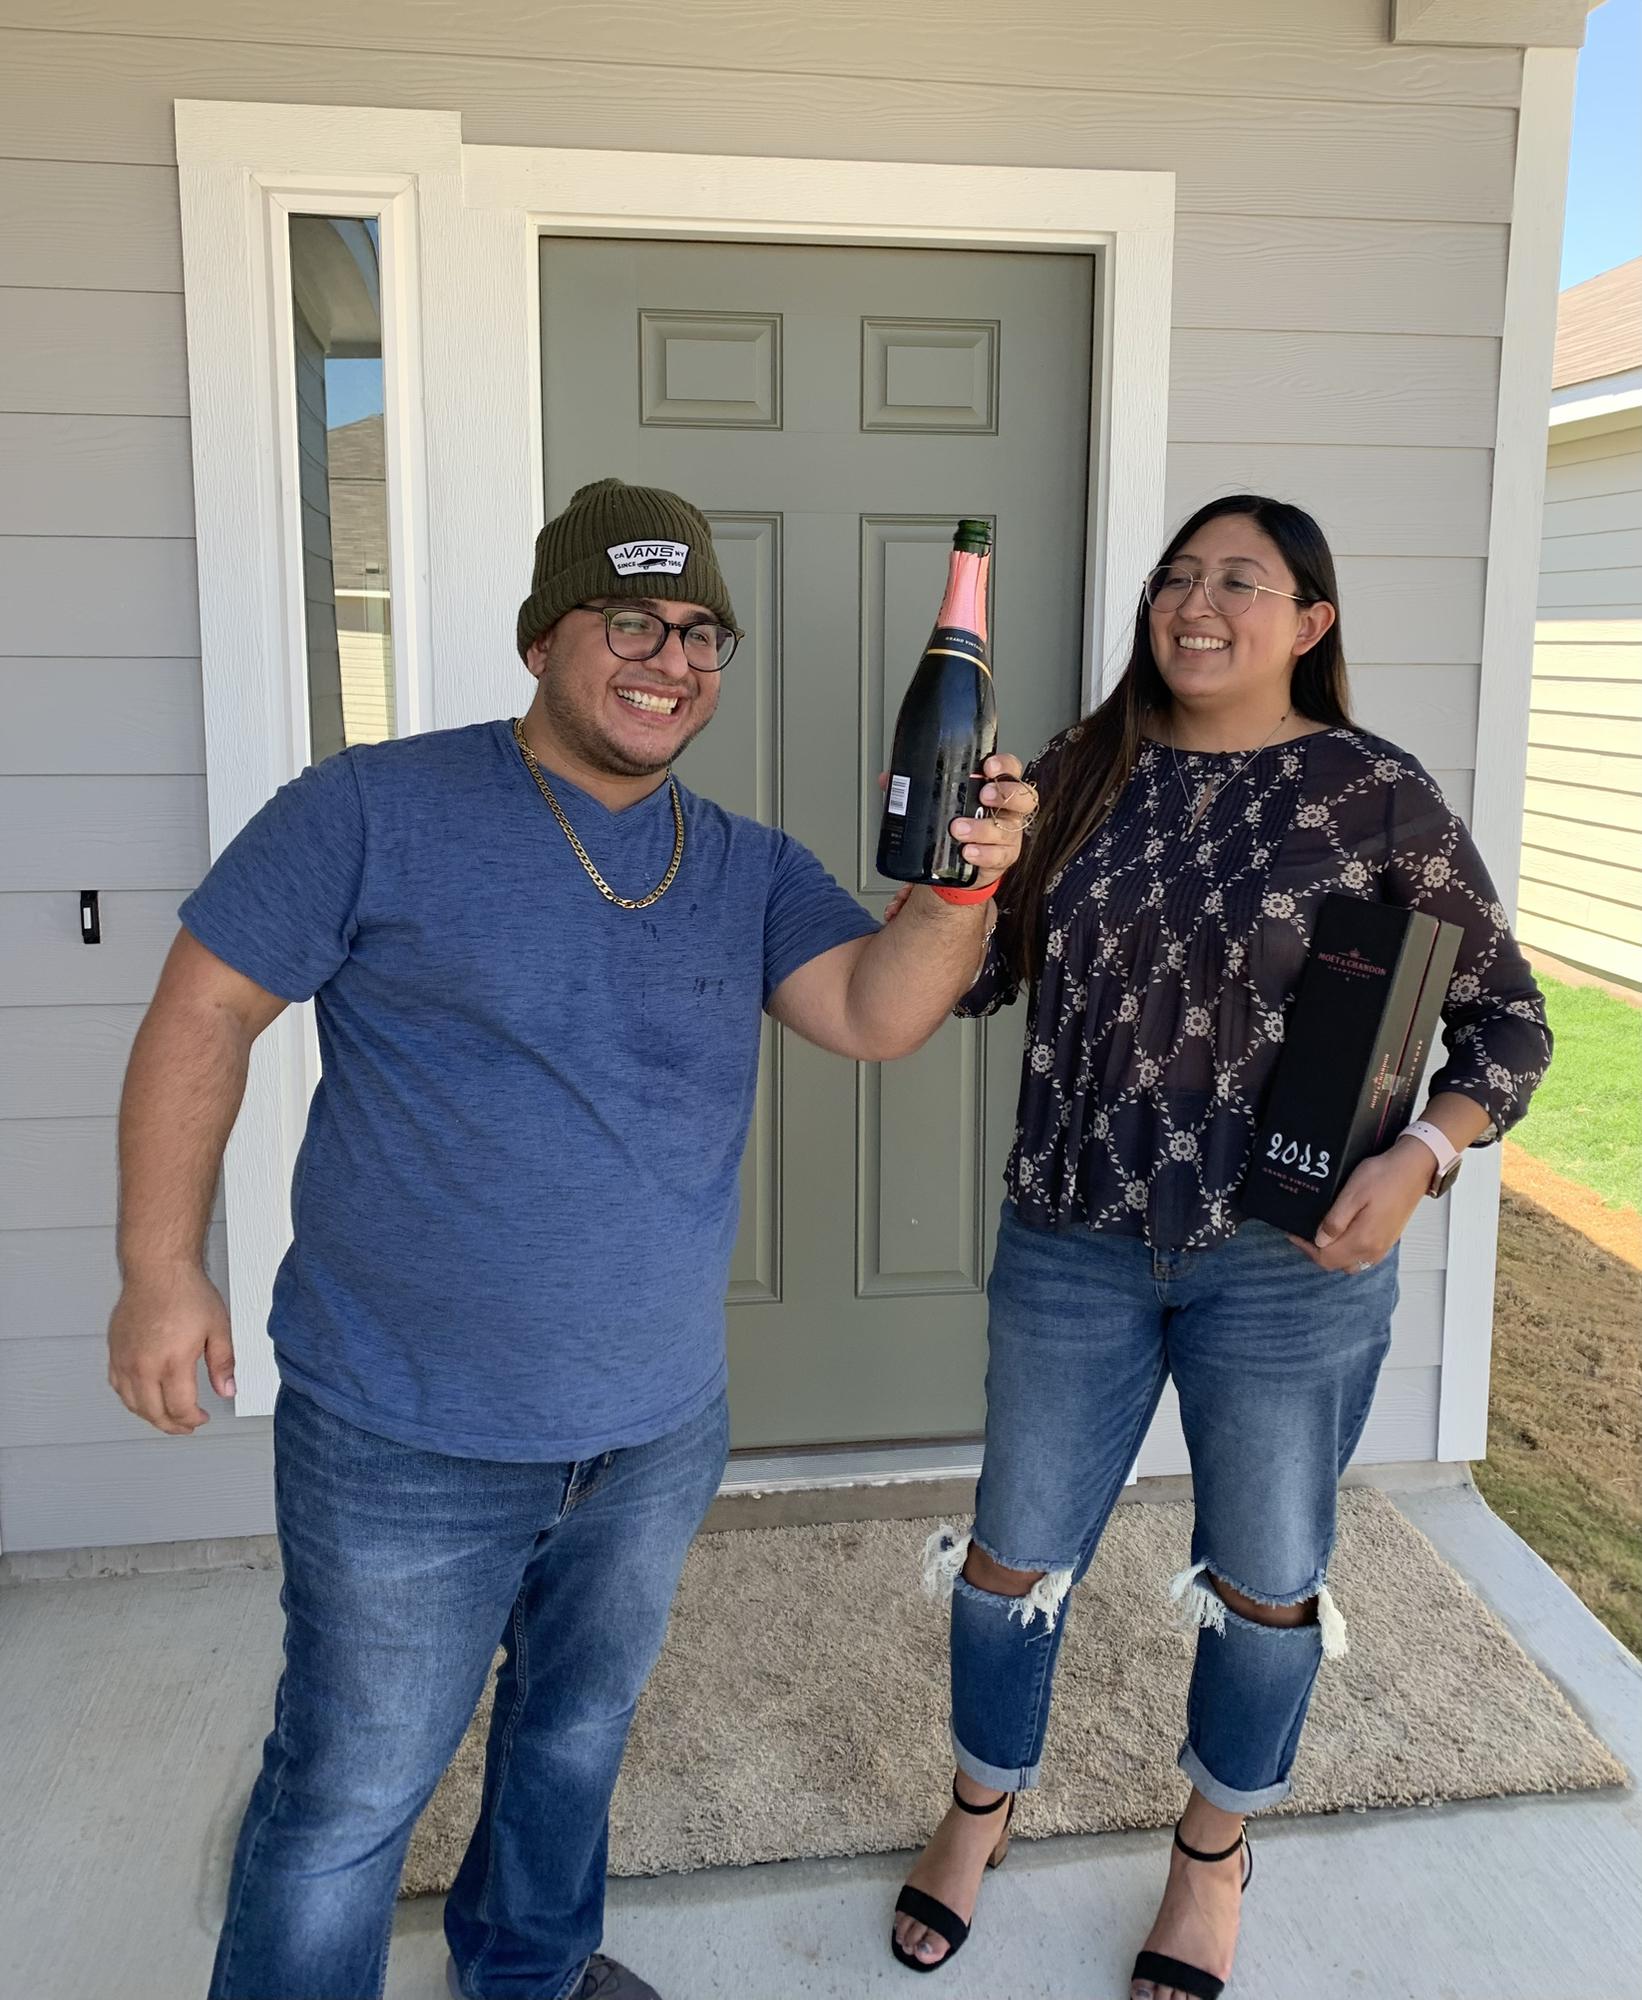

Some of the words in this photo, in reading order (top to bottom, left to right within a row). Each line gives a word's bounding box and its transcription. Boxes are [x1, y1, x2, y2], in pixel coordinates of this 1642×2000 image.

[623, 545, 675, 559] VANS
[617, 561, 636, 570] SINCE
[1346, 960, 1387, 976] CHANDON
[1266, 1132, 1330, 1178] 2013
